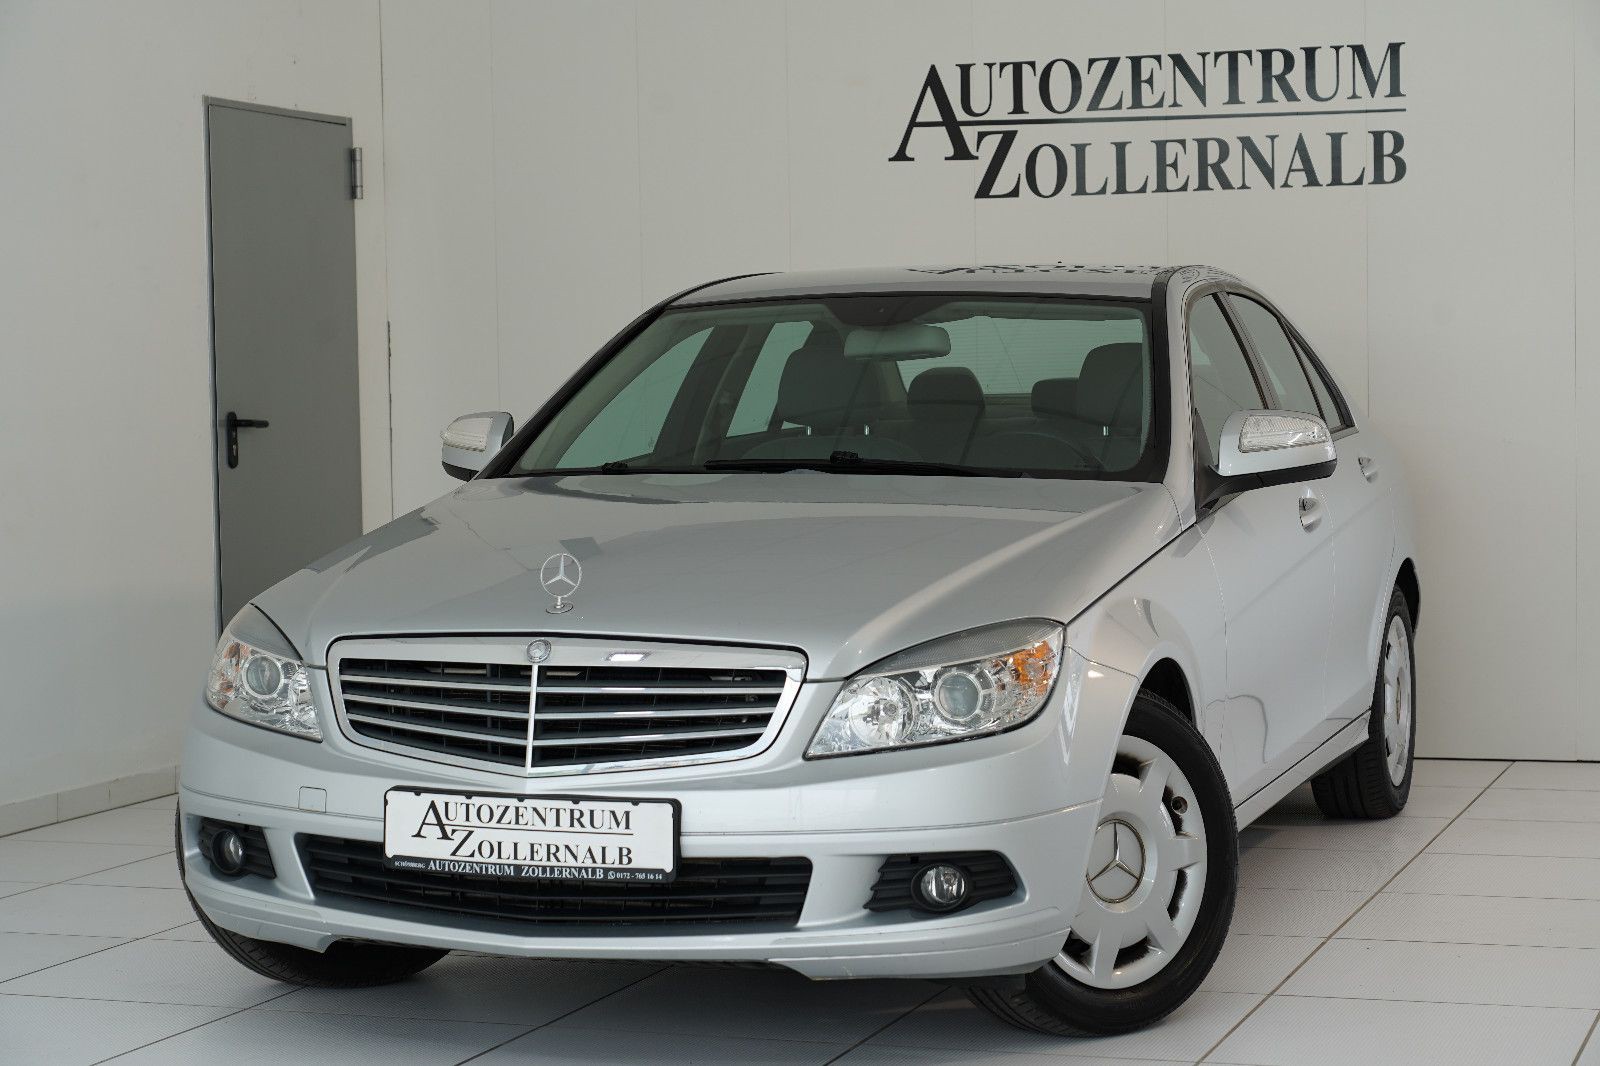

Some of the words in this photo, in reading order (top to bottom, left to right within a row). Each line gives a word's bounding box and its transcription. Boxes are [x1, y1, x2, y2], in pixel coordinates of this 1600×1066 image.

[888, 42, 1406, 161] AUTOZENTRUM
[974, 129, 1407, 199] ZOLLERNALB
[411, 800, 632, 840] AUTOZENTRUM
[450, 829, 632, 865] ZOLLERNALB
[427, 860, 514, 876] AUTOZENTRUM
[521, 865, 604, 879] ZOLLERNALB
